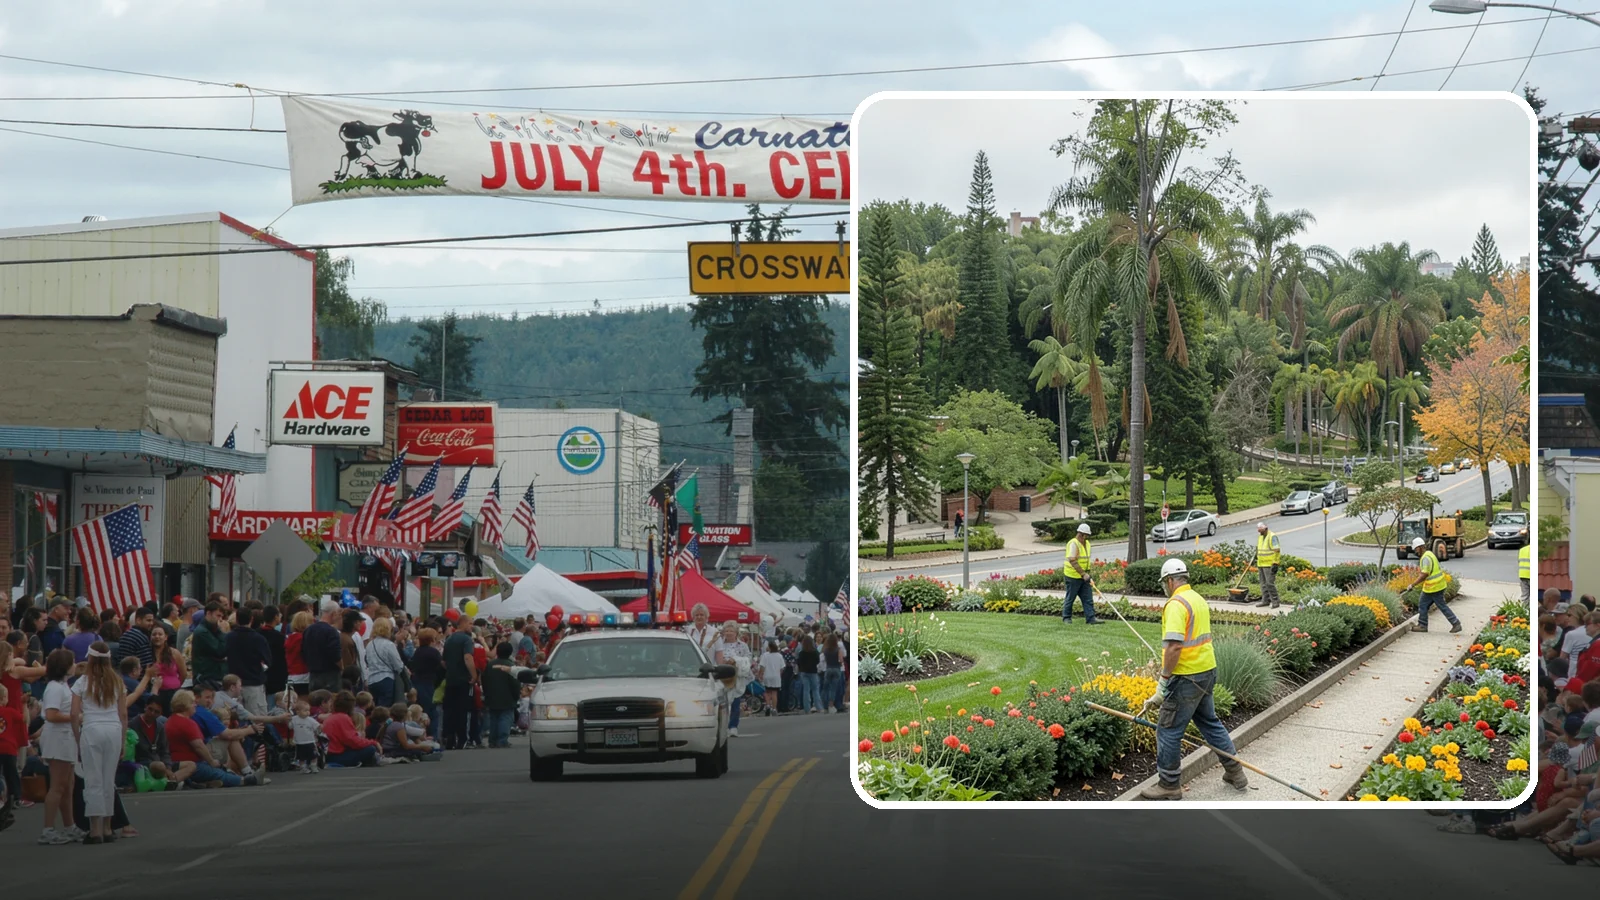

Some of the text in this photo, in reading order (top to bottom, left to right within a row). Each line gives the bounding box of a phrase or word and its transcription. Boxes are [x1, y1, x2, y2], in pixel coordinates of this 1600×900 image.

[695, 121, 850, 150] Carnat
[481, 140, 605, 193] JULY
[632, 150, 746, 197] 4th.
[697, 254, 850, 280] CROSSWA
[282, 380, 374, 420] ACE
[405, 409, 452, 422] CEDAR
[283, 421, 371, 436] Hardware
[353, 467, 386, 480] Simpl
[96, 485, 124, 495] Vincent
[126, 486, 135, 495] de
[137, 486, 155, 495] Paul
[81, 503, 153, 521] THT
[212, 516, 331, 535] HARDARE
[688, 526, 741, 535] CRNATION
[699, 535, 730, 543] GLASS
